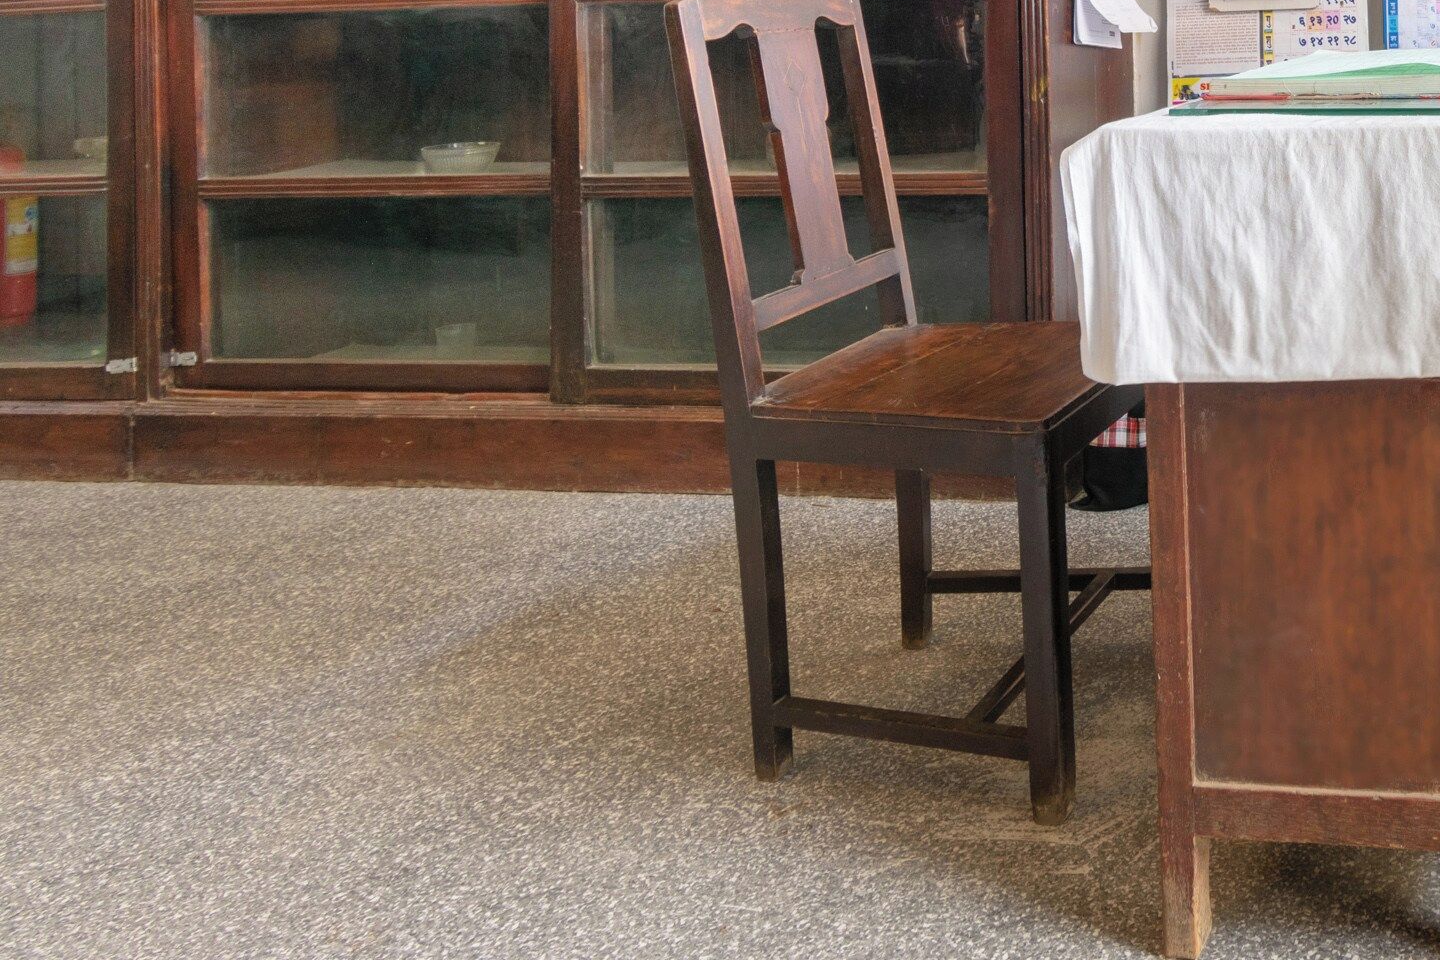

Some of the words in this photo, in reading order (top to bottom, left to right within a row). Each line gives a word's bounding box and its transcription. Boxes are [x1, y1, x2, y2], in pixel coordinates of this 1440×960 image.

[1299, 16, 1305, 27] ६
[1310, 15, 1322, 26] १३
[1326, 15, 1339, 24] २०
[1343, 14, 1356, 24] २७
[1299, 37, 1306, 46] ७
[1310, 36, 1323, 47] १४
[1327, 35, 1339, 46] २१
[1344, 35, 1357, 45] २८
